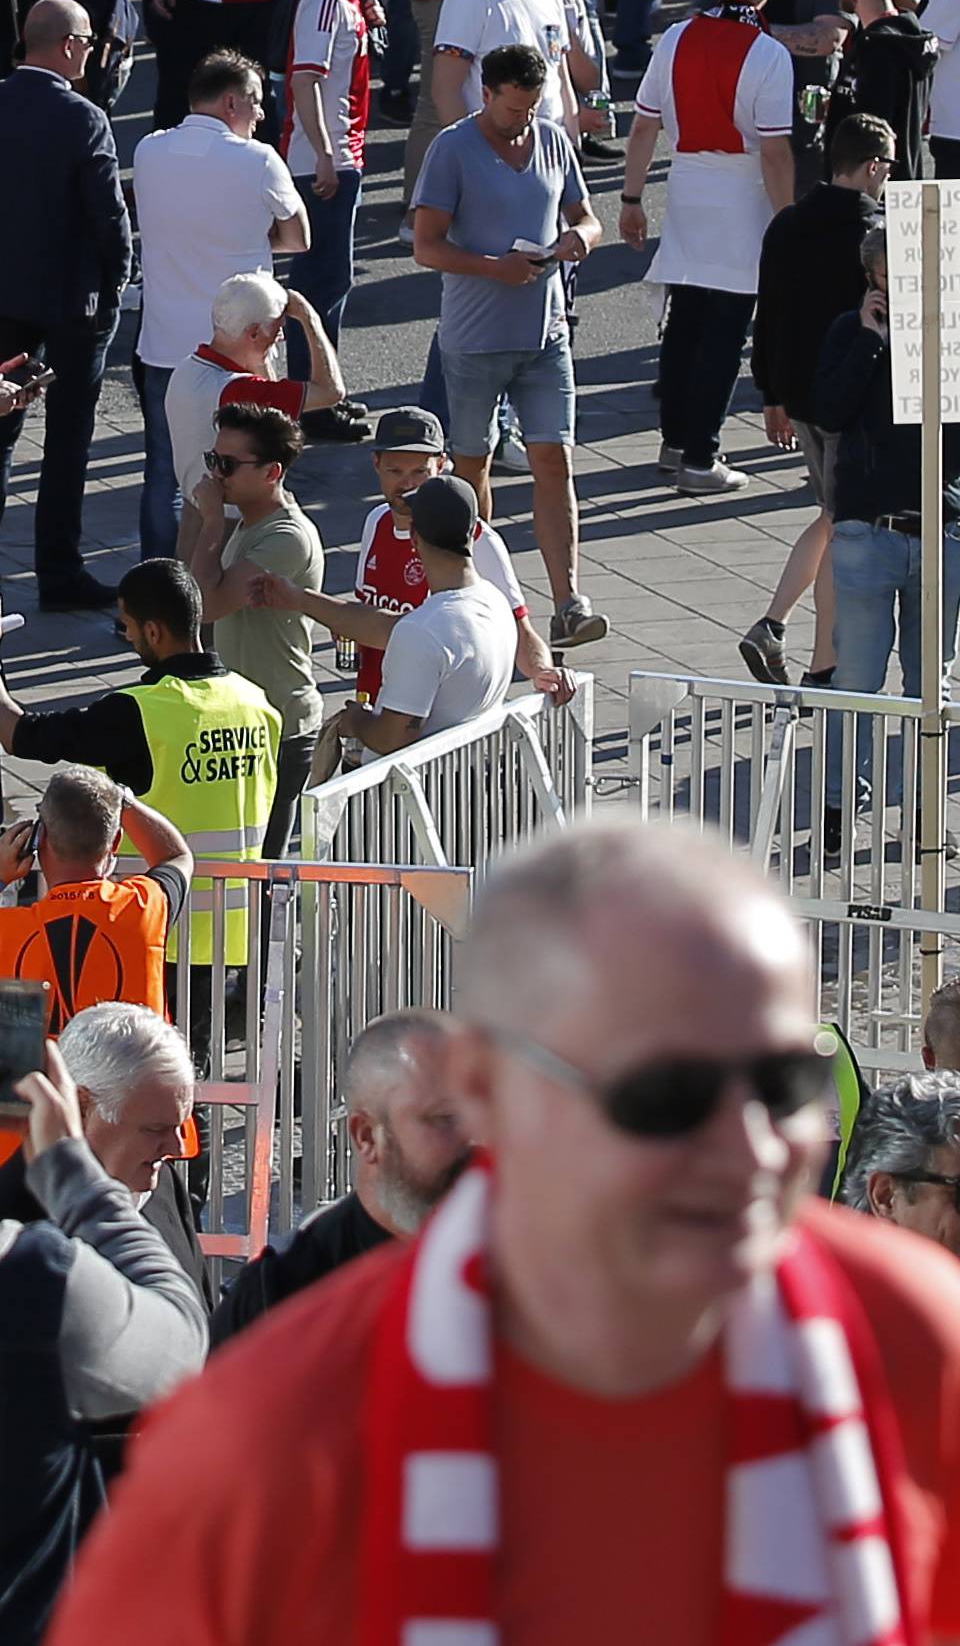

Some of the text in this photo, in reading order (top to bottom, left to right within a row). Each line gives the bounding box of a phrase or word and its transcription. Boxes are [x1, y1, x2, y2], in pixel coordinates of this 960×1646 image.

[199, 725, 266, 755] SERVICE
[180, 742, 264, 785] & SAFETY
[50, 890, 96, 901] 2015/8
